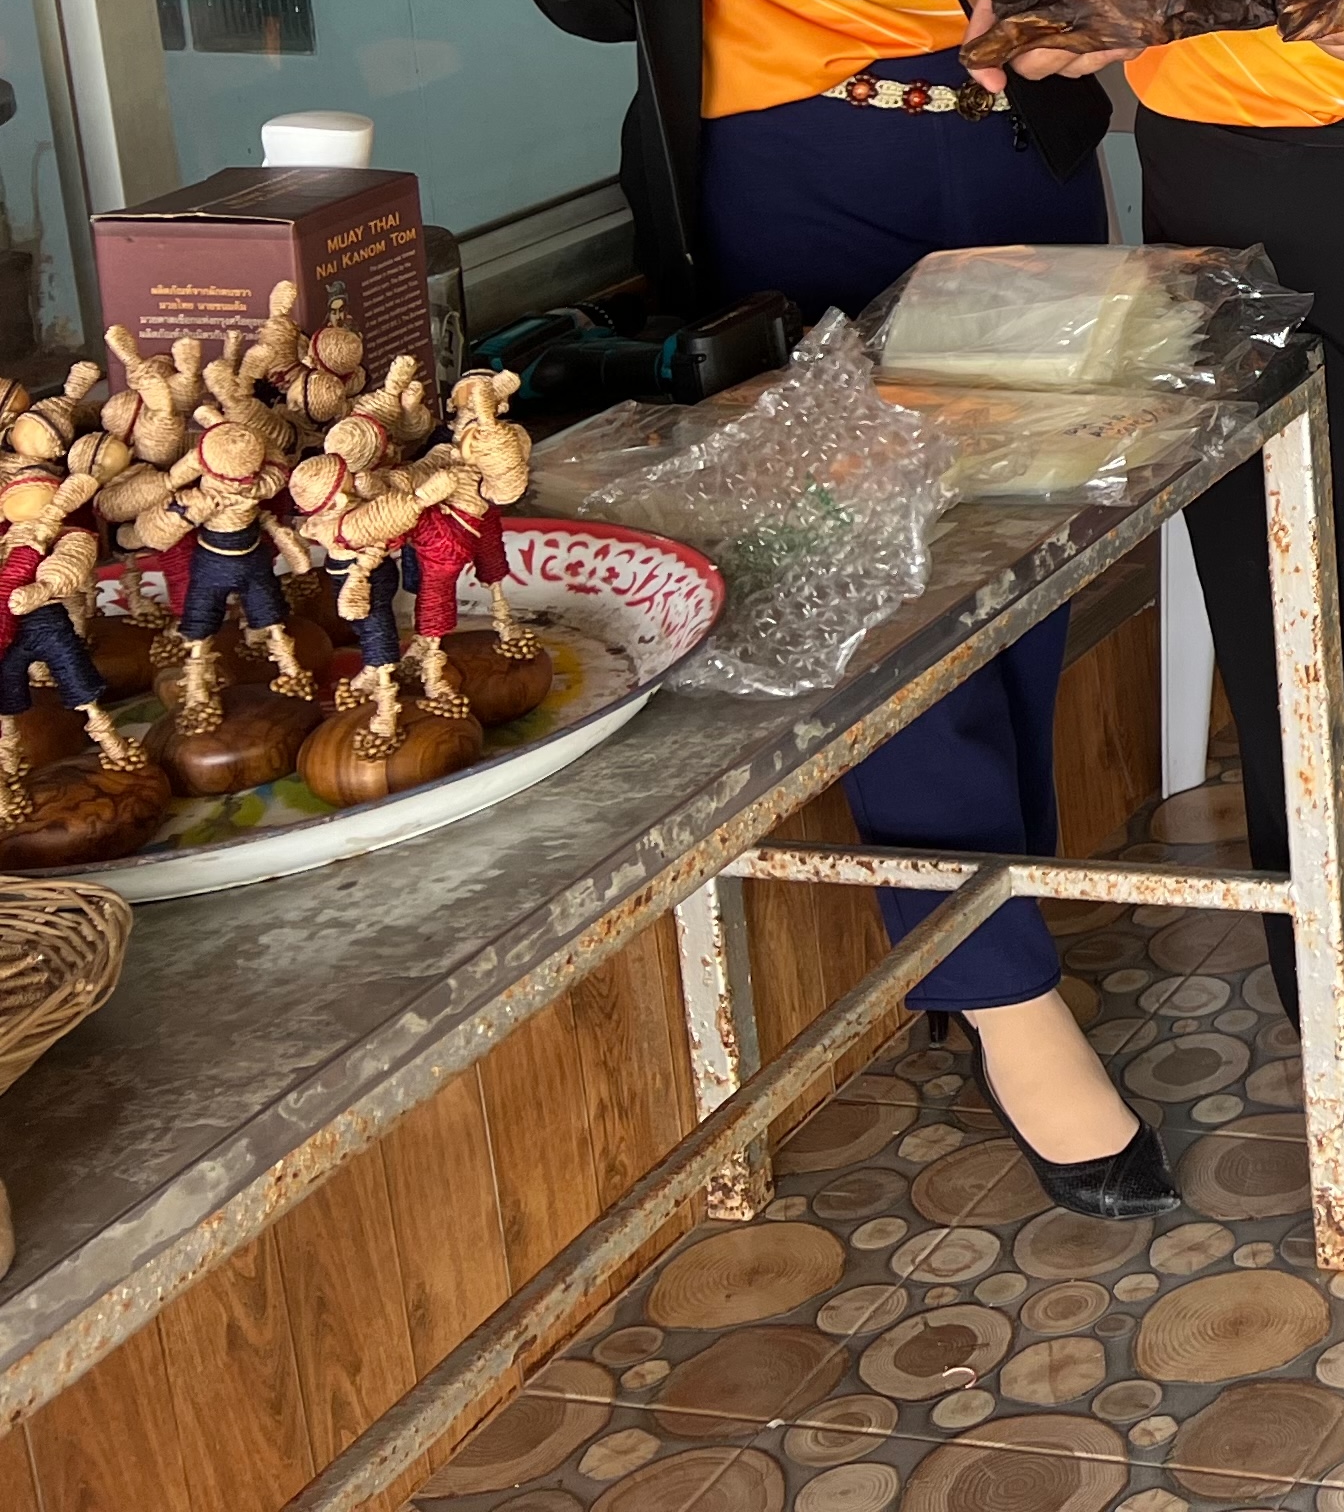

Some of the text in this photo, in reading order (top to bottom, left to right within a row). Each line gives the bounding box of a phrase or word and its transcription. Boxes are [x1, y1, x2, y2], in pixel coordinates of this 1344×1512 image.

[316, 228, 417, 281] NAI KANOM TOM
[327, 211, 400, 254] MUAY THAI
